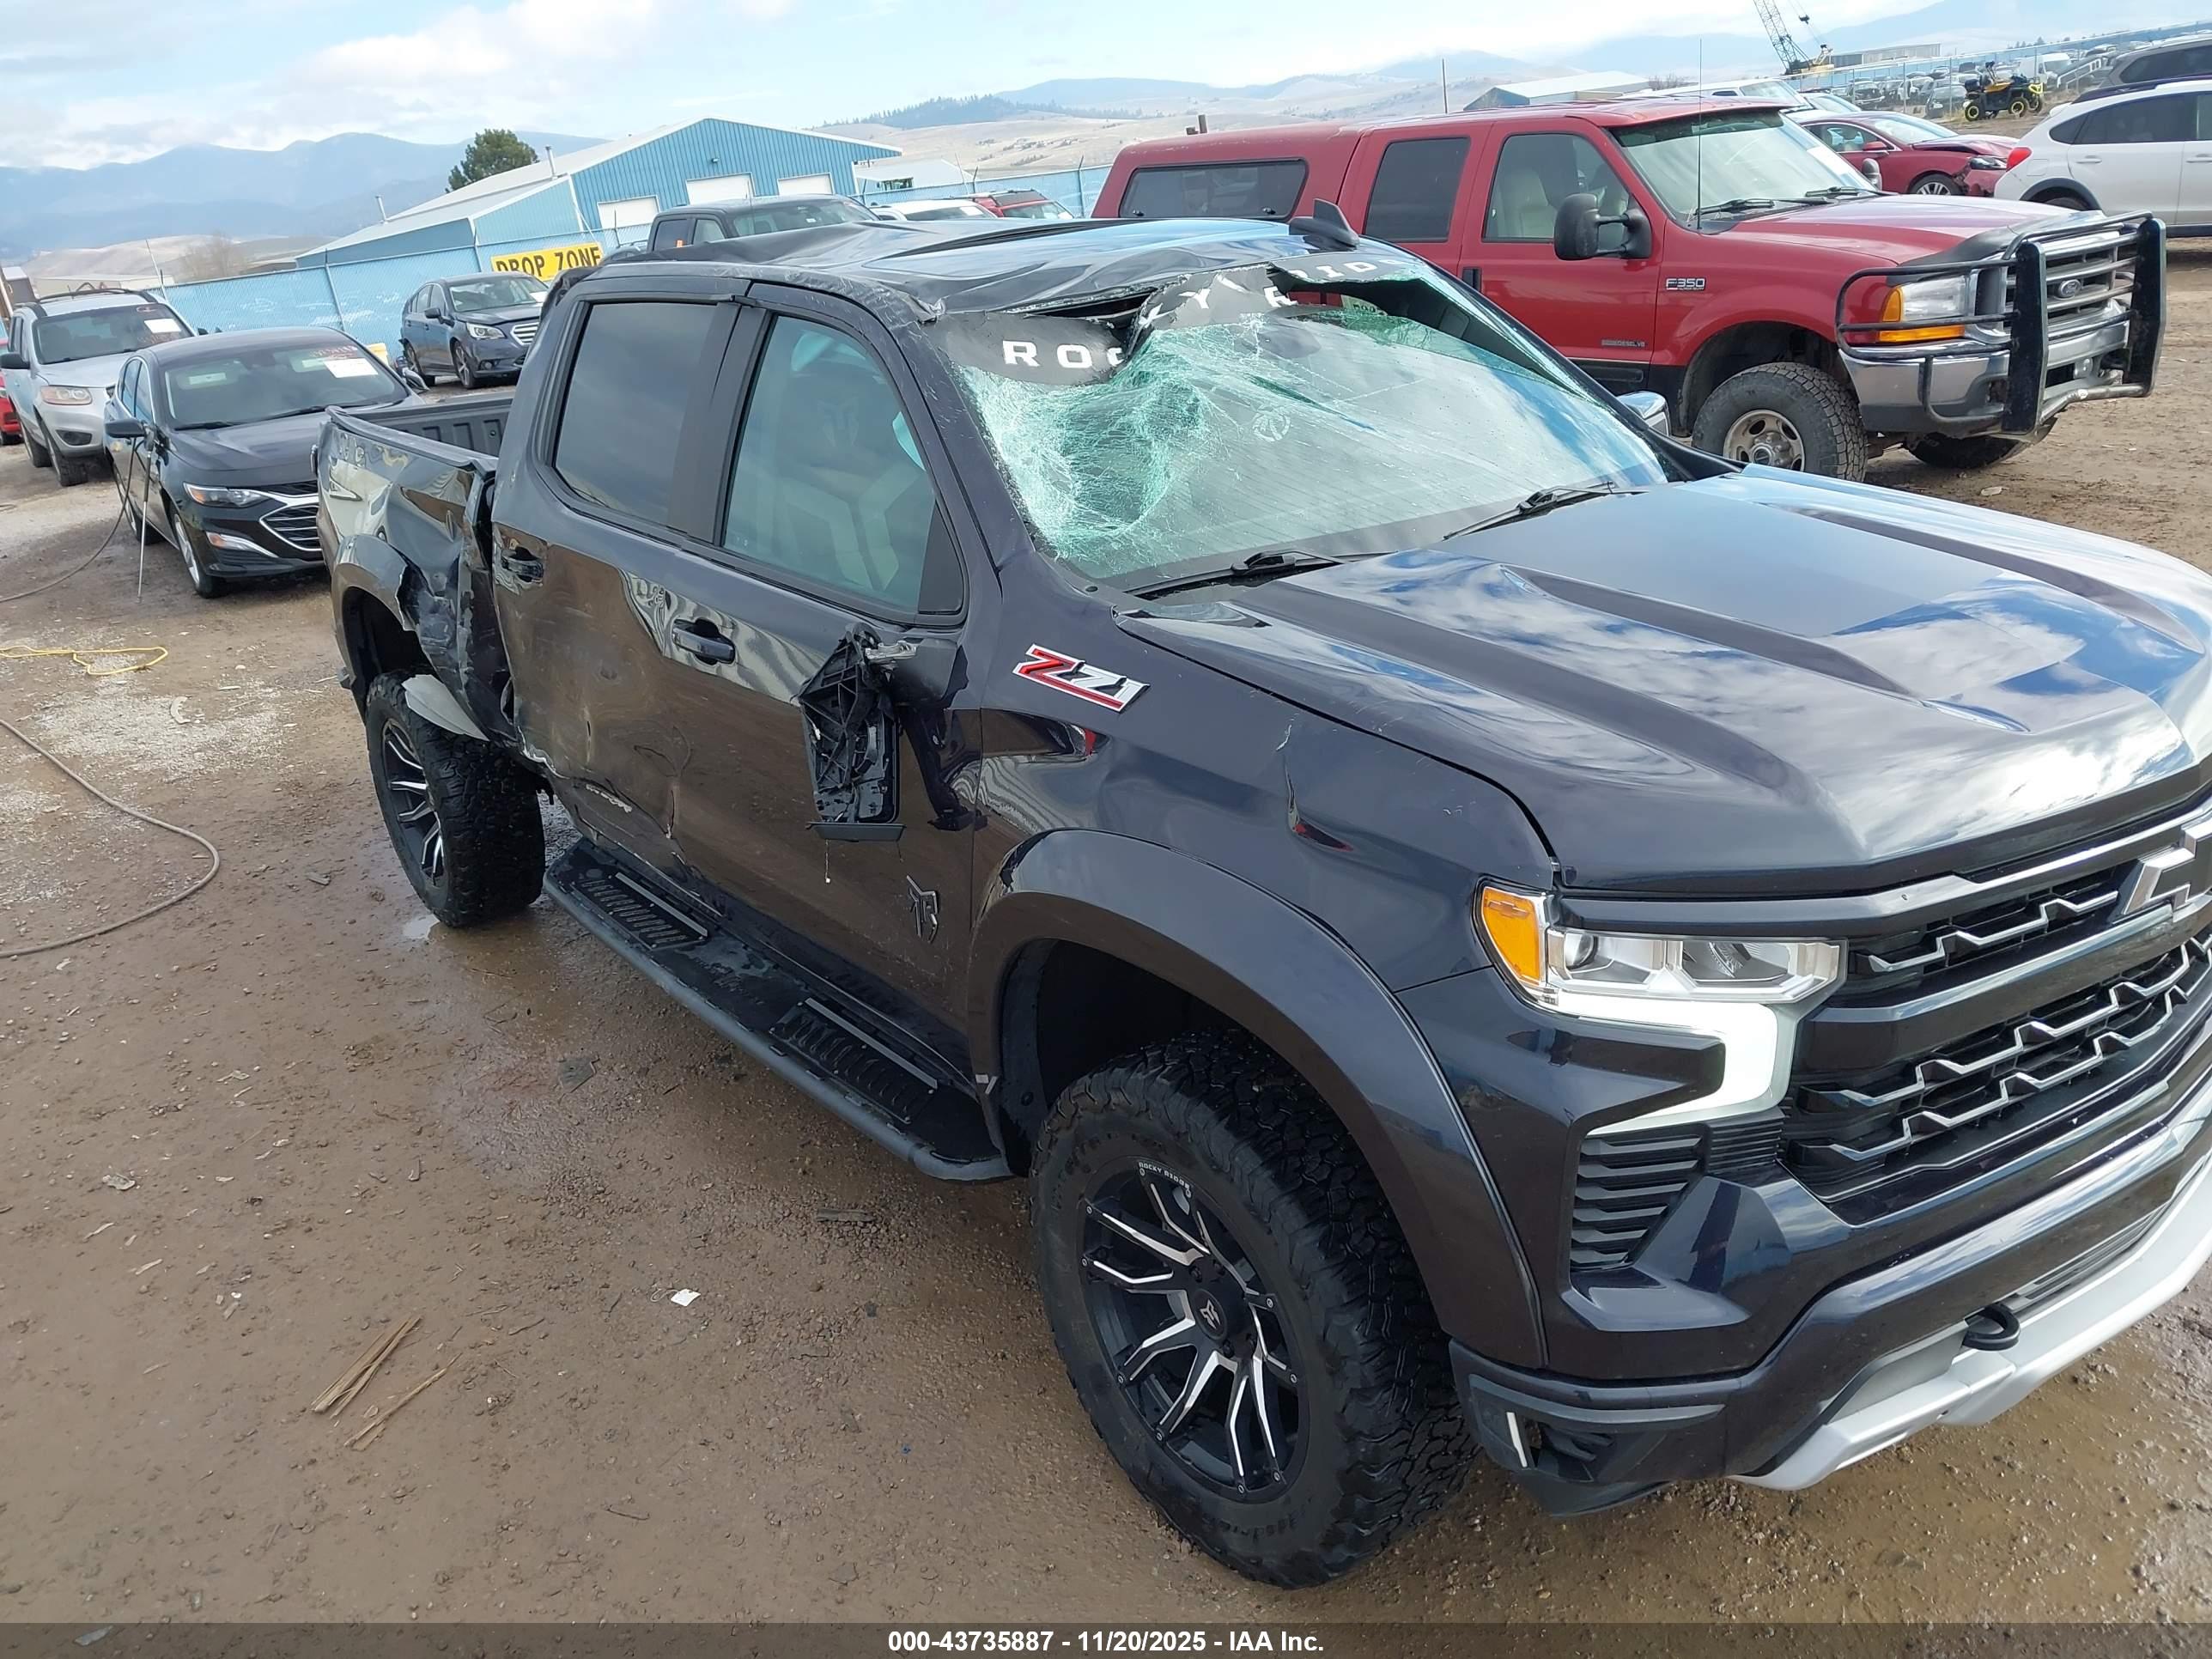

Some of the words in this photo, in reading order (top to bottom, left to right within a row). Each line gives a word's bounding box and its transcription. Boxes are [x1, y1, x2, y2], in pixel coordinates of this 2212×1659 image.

[555, 246, 601, 270] ZONE
[1012, 643, 1151, 714] Z71
[1139, 1161, 1162, 1173] ROCKY
